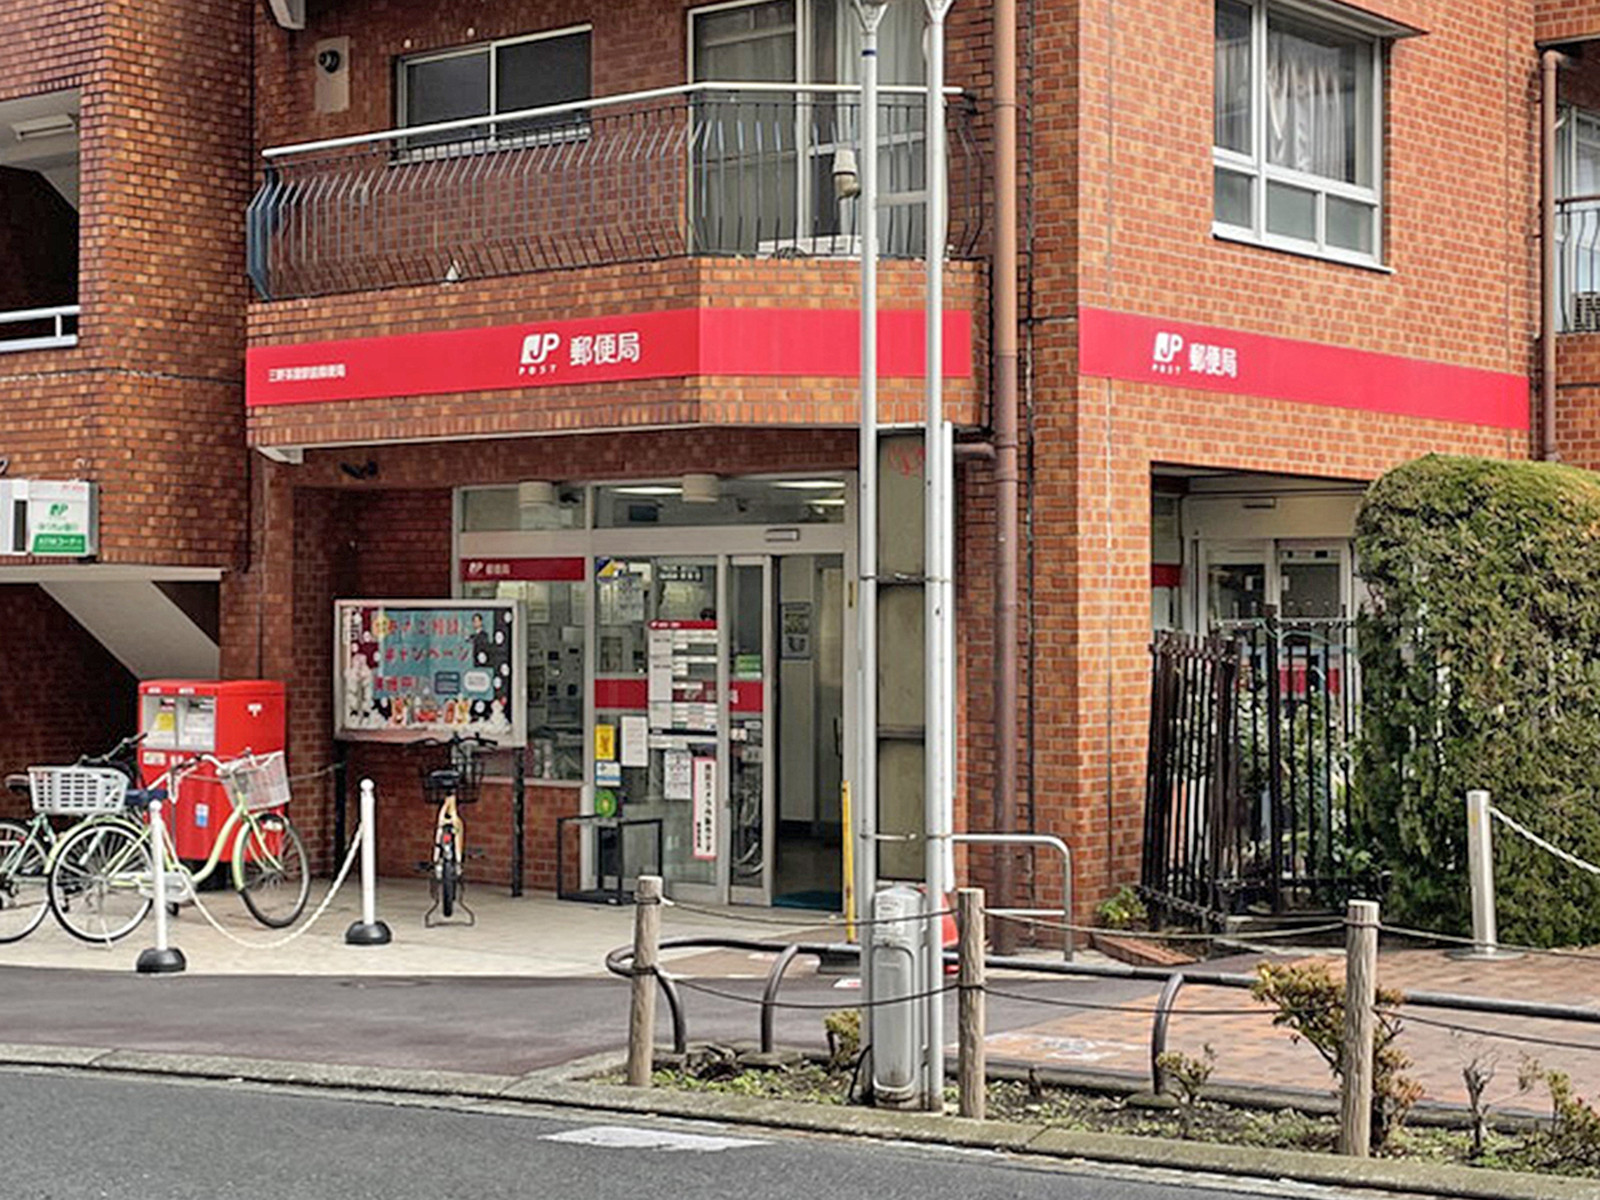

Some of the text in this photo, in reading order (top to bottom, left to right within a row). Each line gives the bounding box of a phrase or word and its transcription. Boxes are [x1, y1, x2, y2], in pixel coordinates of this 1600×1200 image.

[569, 332, 640, 366] 郵便局
[1189, 343, 1238, 378] 郵便局
[518, 364, 558, 376] POST
[1151, 363, 1182, 375] POST
